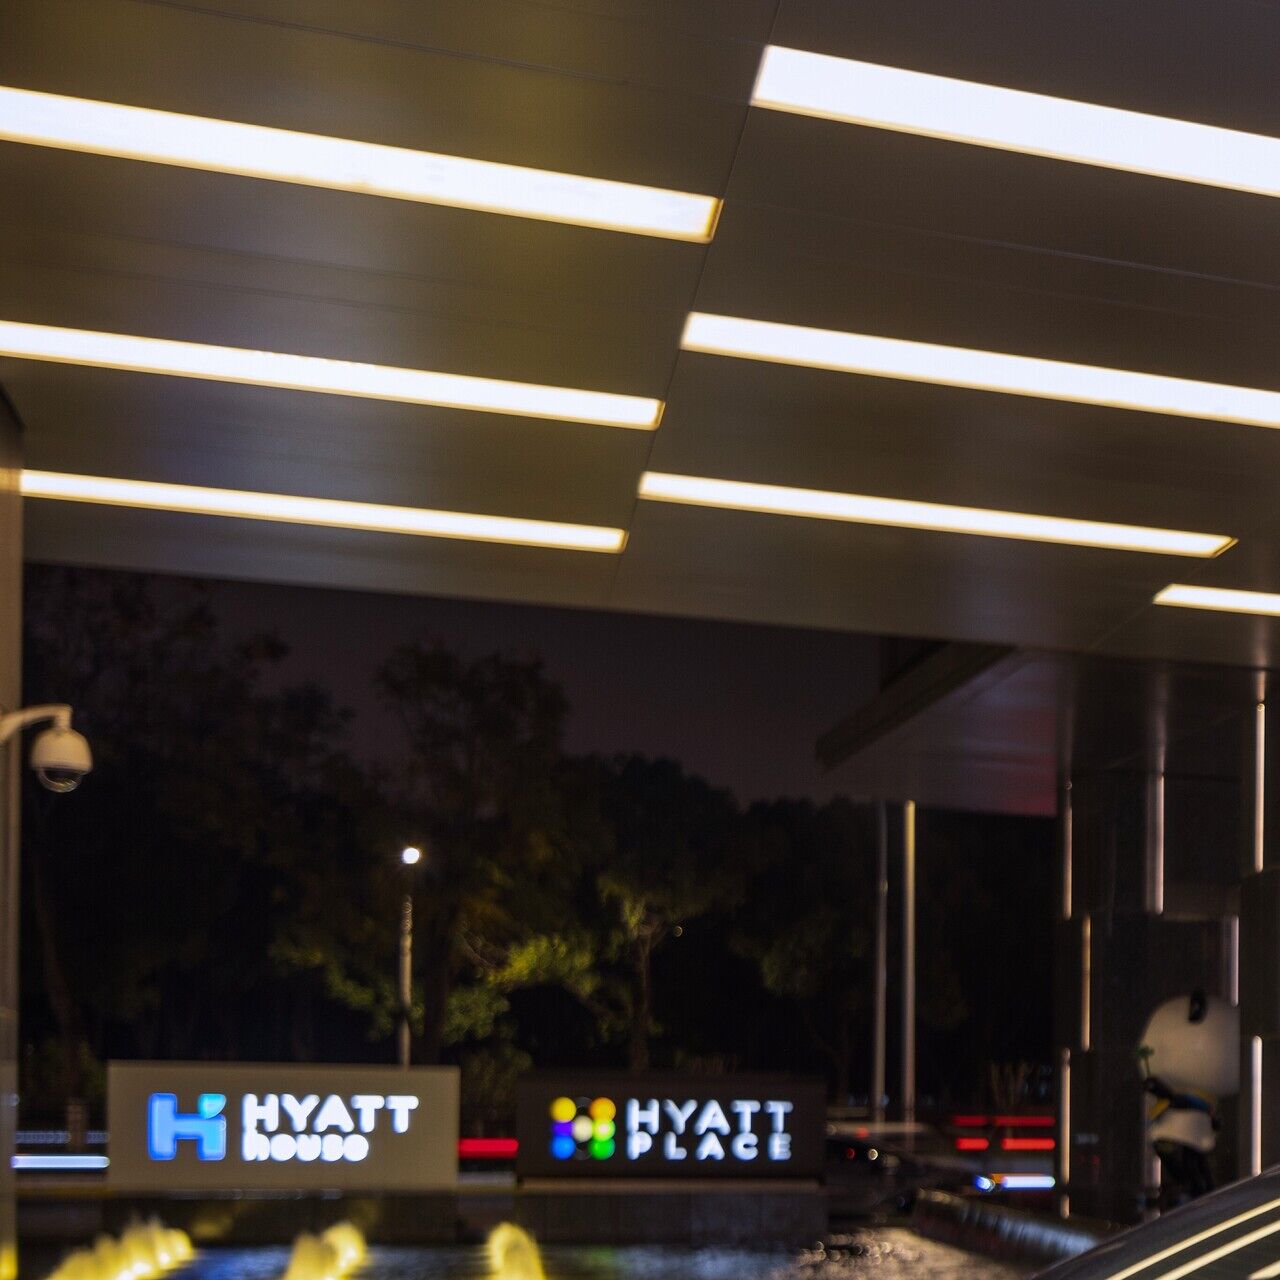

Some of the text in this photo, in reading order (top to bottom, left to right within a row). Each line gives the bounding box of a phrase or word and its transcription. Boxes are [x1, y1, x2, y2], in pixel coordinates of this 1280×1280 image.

[243, 1093, 420, 1133] HYATT
[628, 1099, 793, 1132] HYATT
[243, 1131, 369, 1161] house
[628, 1132, 792, 1160] PLACE
